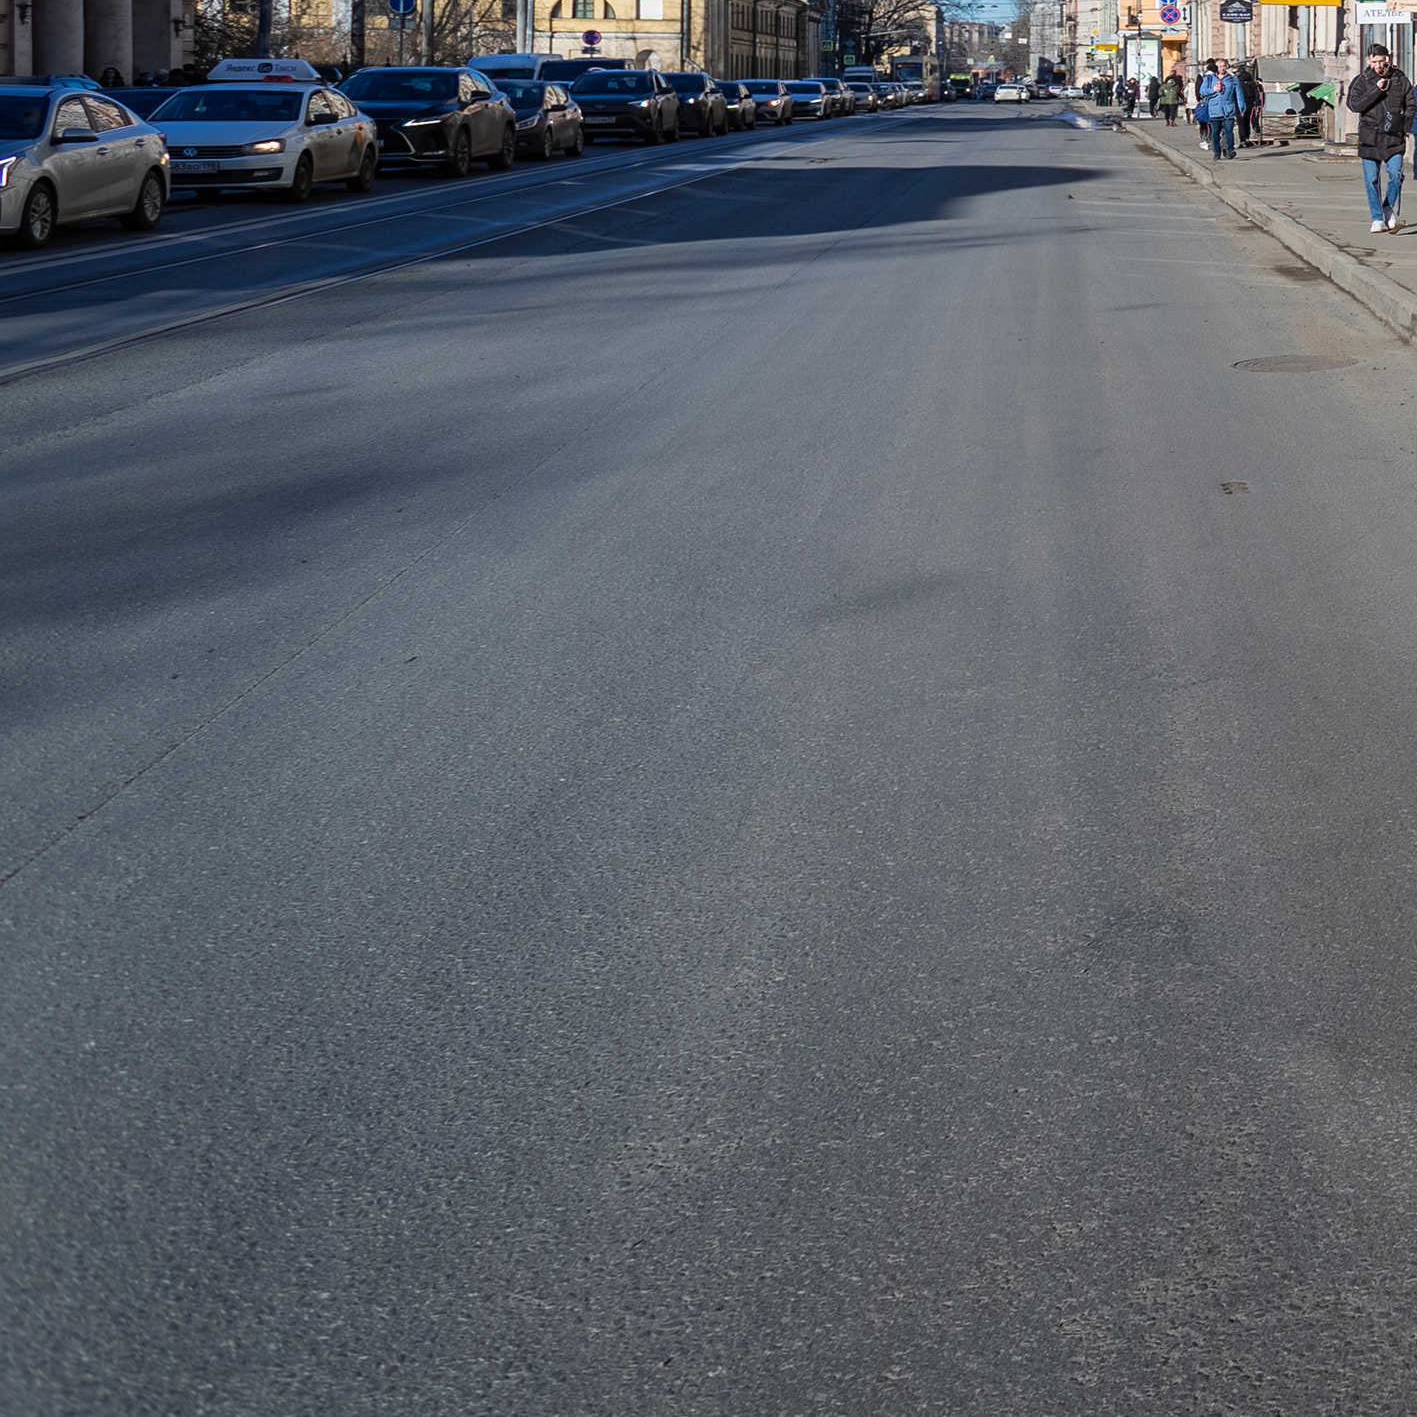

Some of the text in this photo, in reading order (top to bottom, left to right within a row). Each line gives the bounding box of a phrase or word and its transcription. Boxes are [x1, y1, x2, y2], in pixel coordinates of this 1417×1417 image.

[1363, 9, 1405, 17] АТЕЛЬЕ
[225, 63, 297, 72] Яндекс Go Такси
